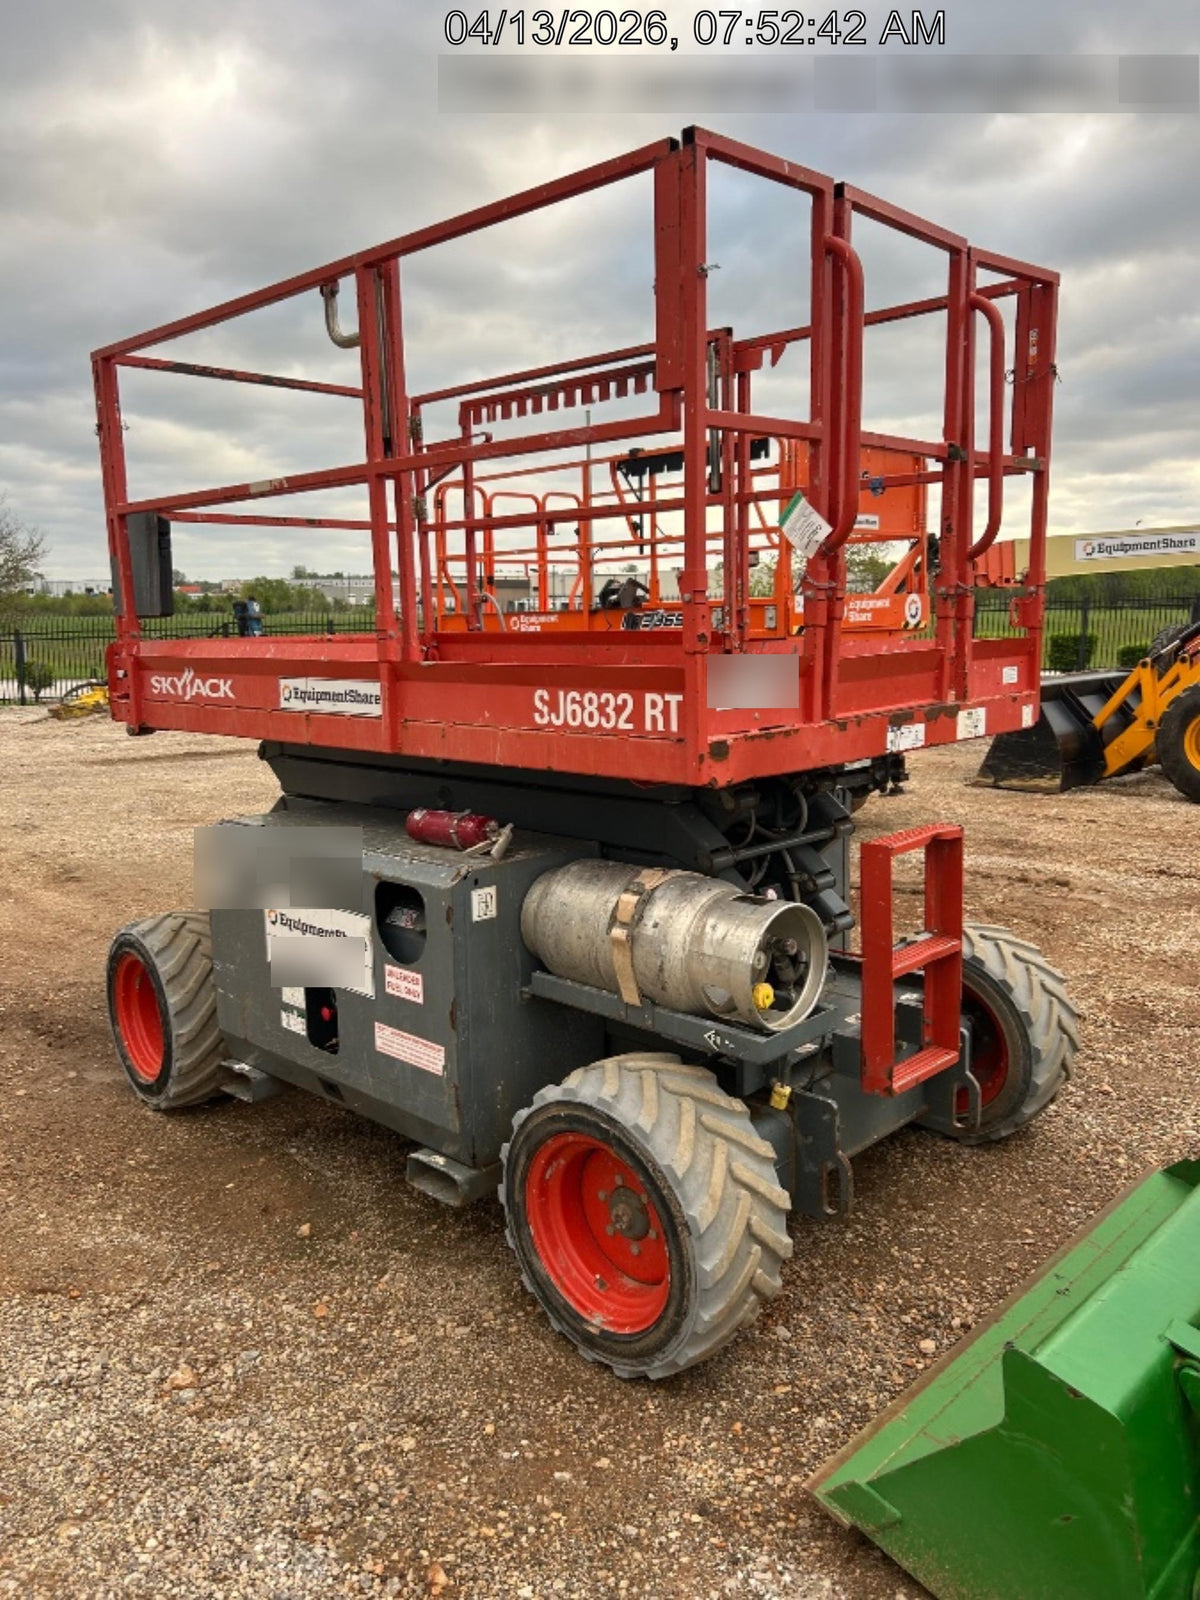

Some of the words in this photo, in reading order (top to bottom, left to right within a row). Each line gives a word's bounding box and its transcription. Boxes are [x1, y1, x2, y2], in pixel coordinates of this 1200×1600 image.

[1097, 538, 1196, 555] EquipmentShare
[150, 667, 235, 700] SKYJACK
[292, 686, 381, 705] EquipmentShare
[533, 689, 634, 730] SJ6832
[644, 693, 683, 733] RT
